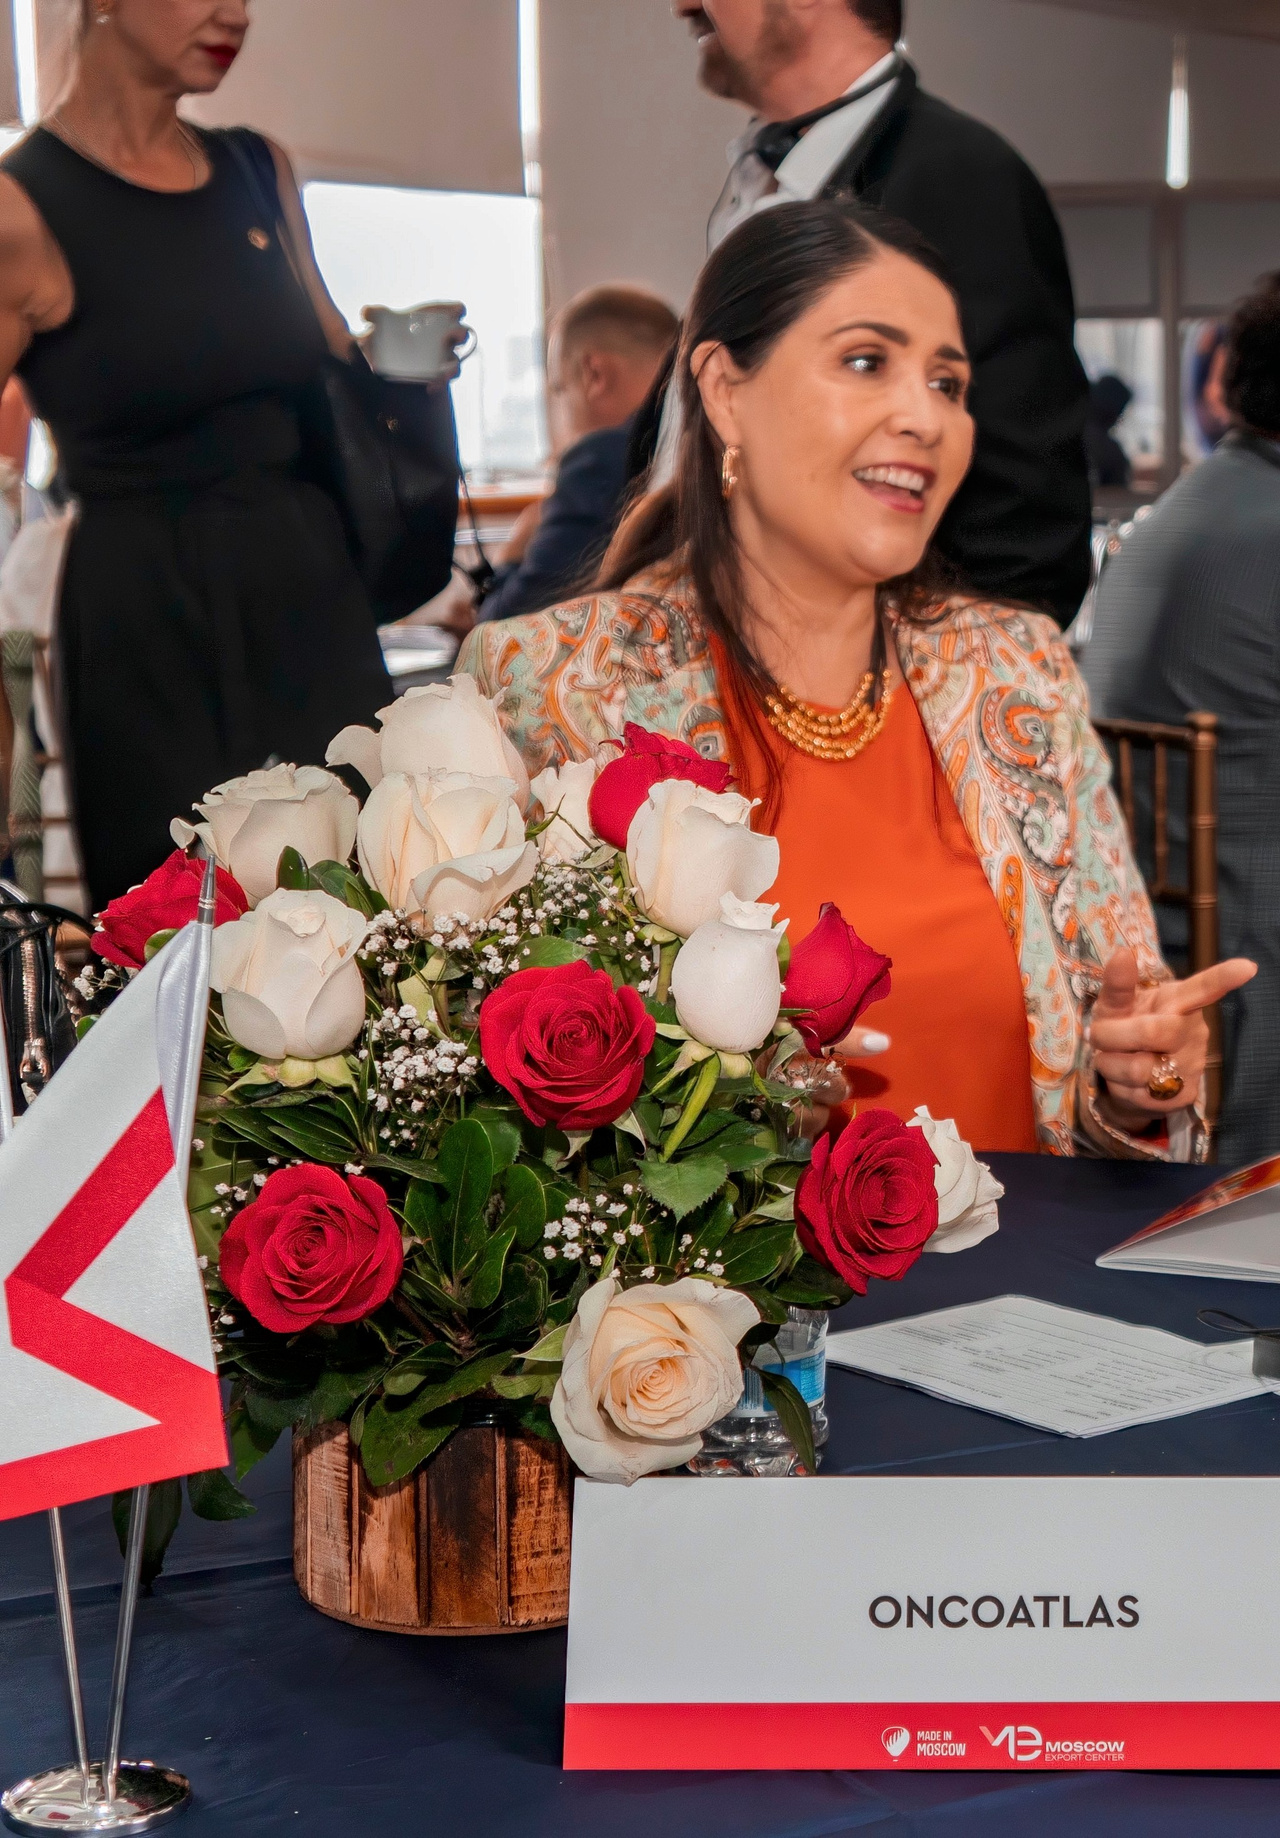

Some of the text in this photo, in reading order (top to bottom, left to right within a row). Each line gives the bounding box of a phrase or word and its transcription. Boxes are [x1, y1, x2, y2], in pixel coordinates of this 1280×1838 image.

[868, 1594, 1140, 1629] ONCOATLAS
[917, 1731, 952, 1741] MADE IN
[917, 1743, 966, 1756] MOSCOW
[1045, 1741, 1125, 1753] MOSCOW
[1045, 1753, 1125, 1761] EXPORT CENTER
